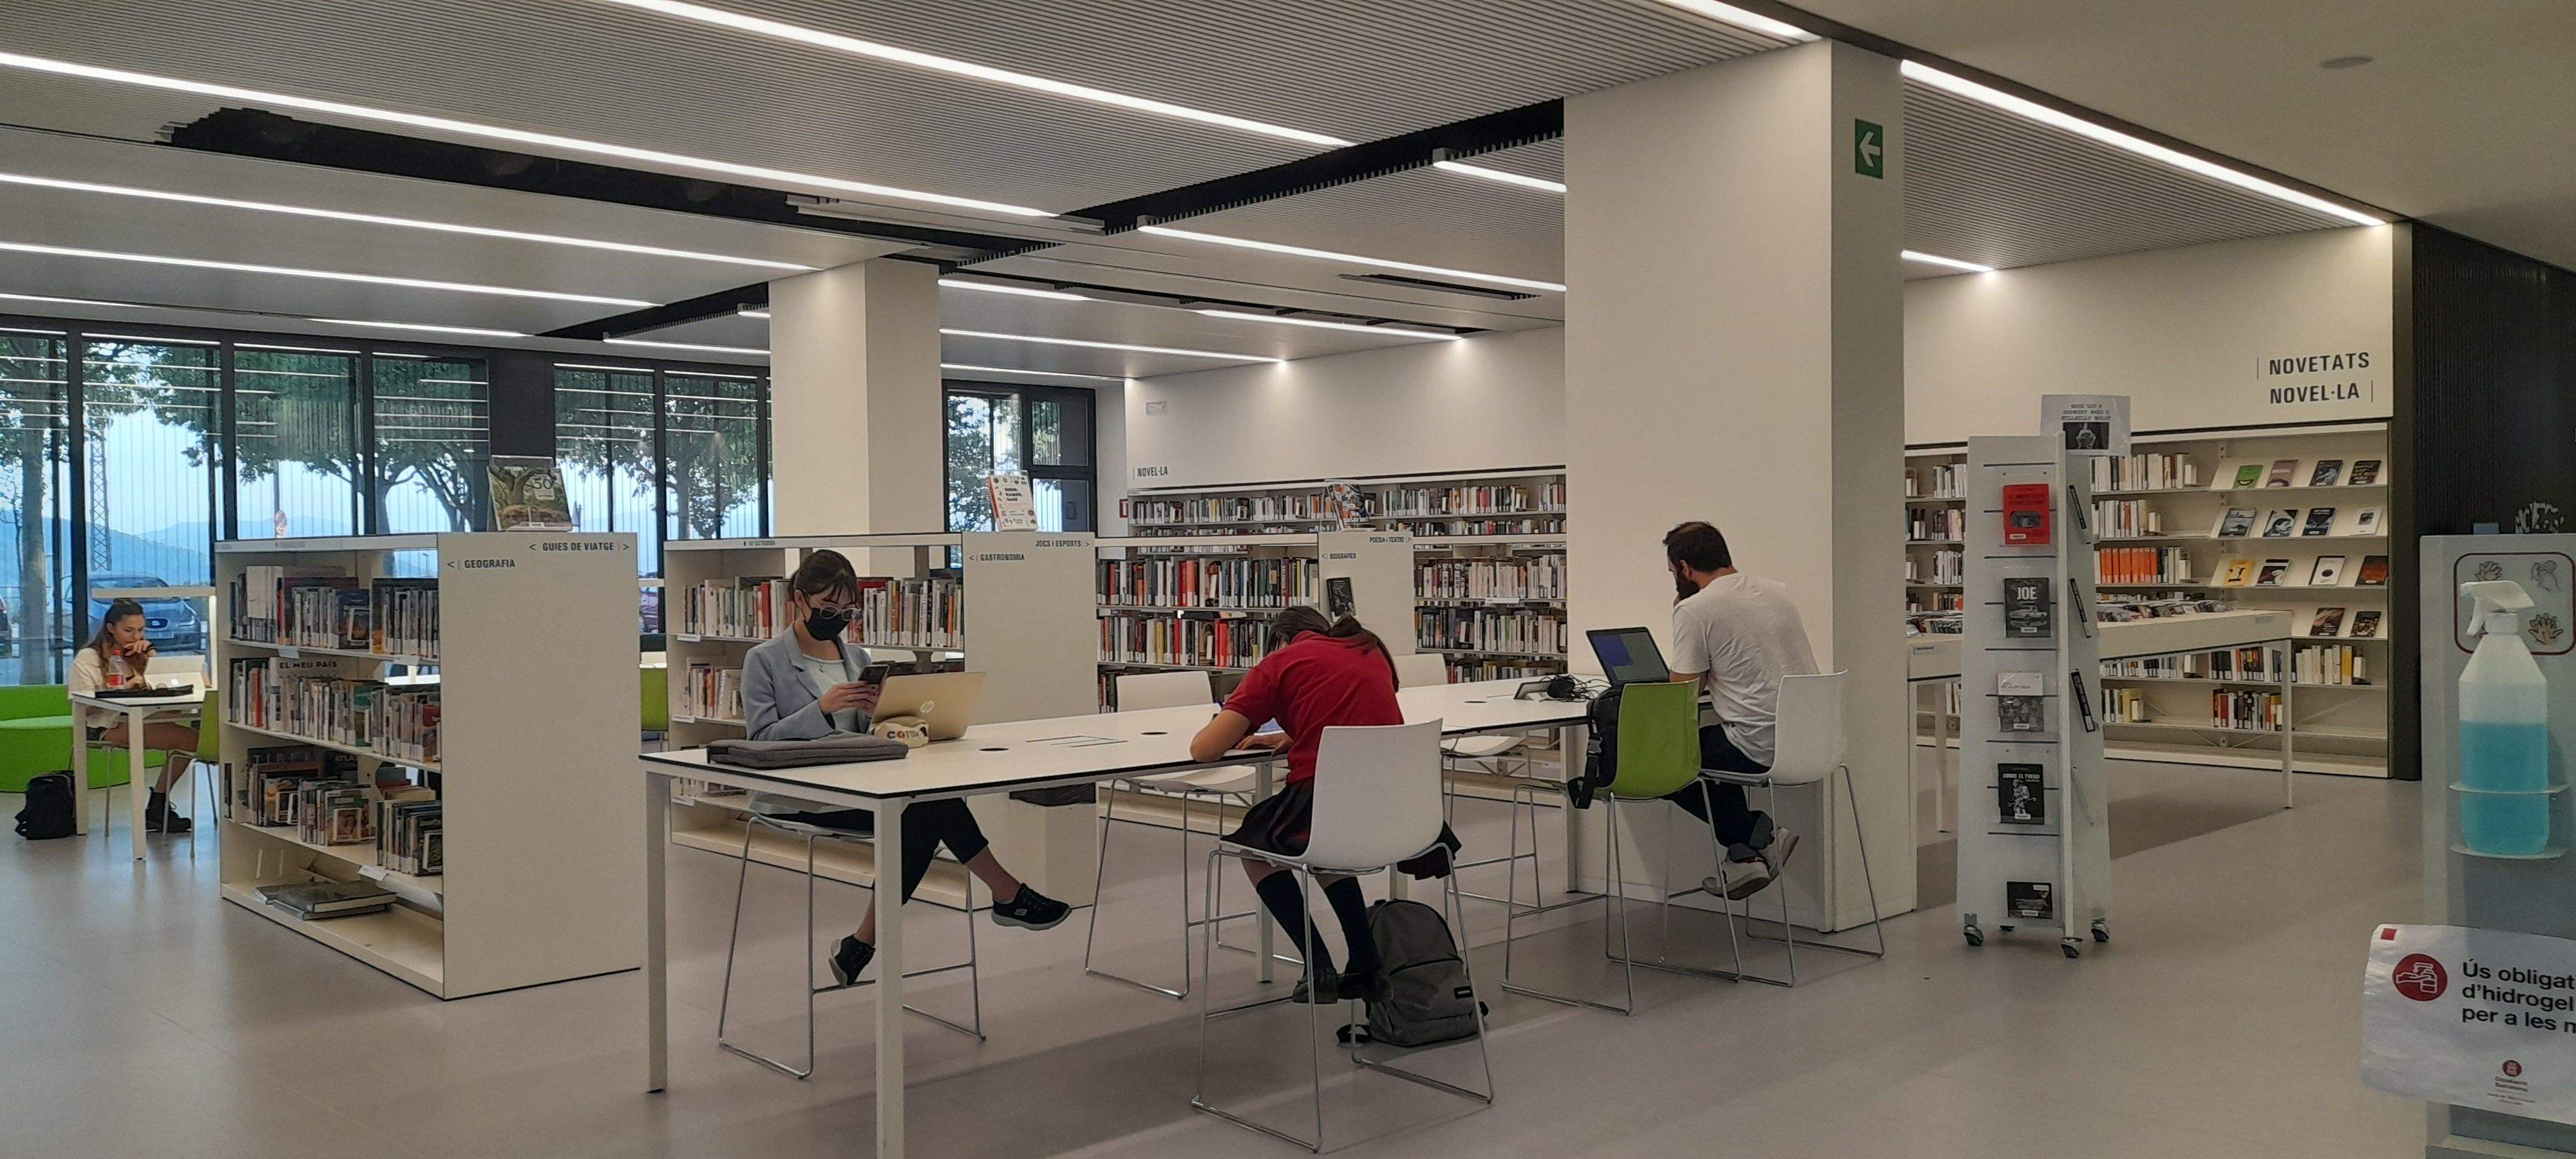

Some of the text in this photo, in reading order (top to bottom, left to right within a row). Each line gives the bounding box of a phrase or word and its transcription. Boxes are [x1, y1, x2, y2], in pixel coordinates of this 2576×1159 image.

[2269, 352, 2370, 375] NOVETATS
[2270, 382, 2360, 405] NOVEL·LA
[1137, 466, 1168, 477] NOVEL·LA
[542, 542, 614, 551] GUIES DE VIATGE
[464, 559, 515, 569] GEOGRAFIA
[2016, 587, 2038, 600] JOE
[2463, 958, 2491, 979] Ús
[2462, 1008, 2499, 1023] per
[2504, 1013, 2517, 1026] a
[2524, 1012, 2557, 1031] les
